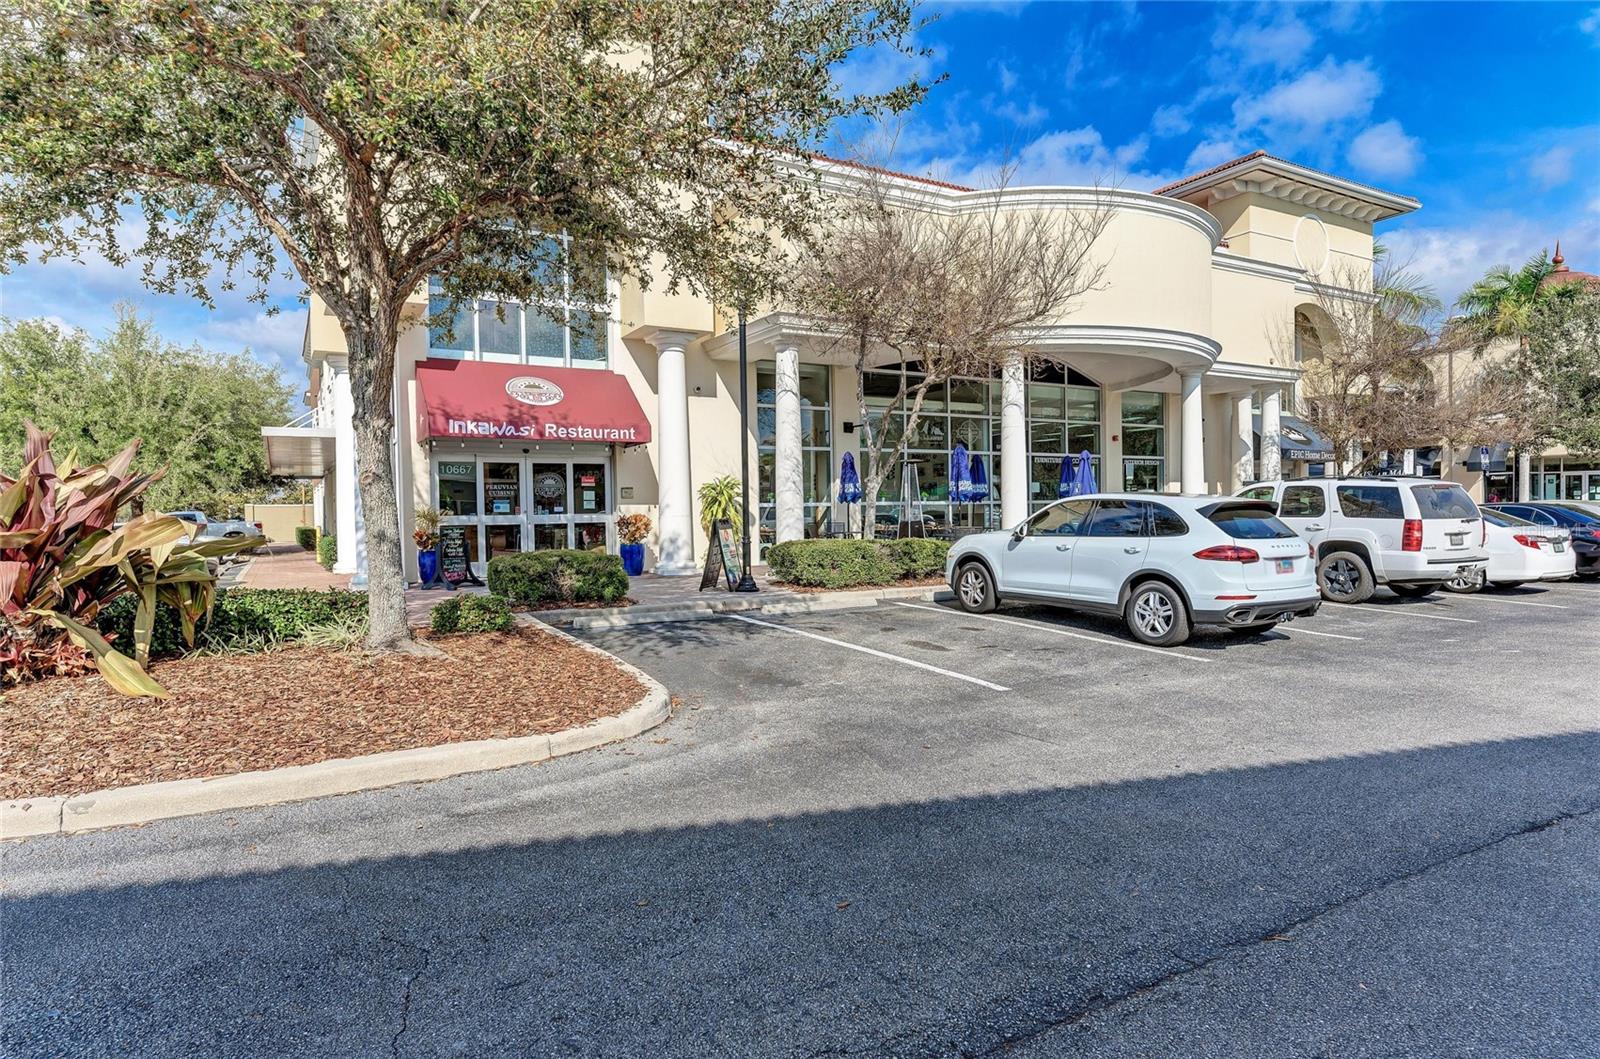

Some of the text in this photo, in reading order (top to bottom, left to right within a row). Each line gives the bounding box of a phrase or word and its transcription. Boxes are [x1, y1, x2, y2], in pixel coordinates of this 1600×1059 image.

[545, 424, 636, 440] Restaurant
[1290, 450, 1305, 459] EPIC
[1305, 451, 1320, 459] Home
[440, 464, 473, 474] 10667
